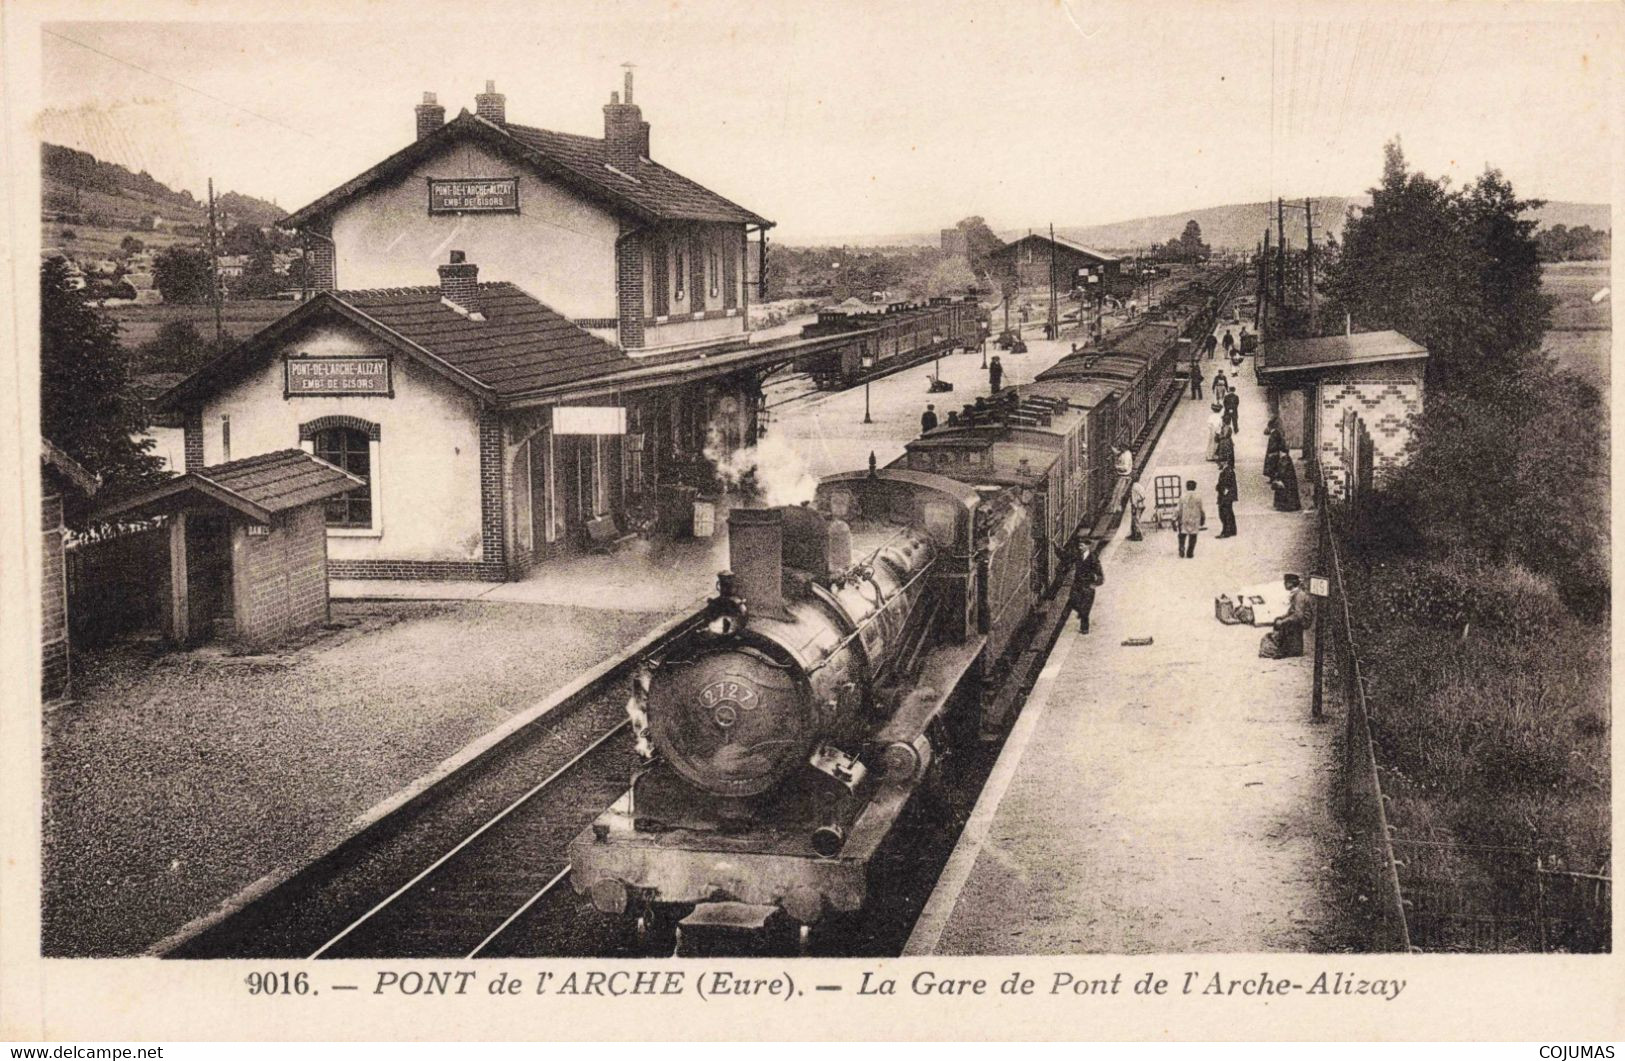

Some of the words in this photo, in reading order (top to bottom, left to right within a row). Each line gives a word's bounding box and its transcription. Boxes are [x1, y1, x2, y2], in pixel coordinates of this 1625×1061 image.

[464, 198, 473, 206] DE
[477, 198, 504, 206] GISORS
[327, 379, 338, 388] DE
[342, 379, 374, 388] GISORS
[704, 683, 754, 704] 2727
